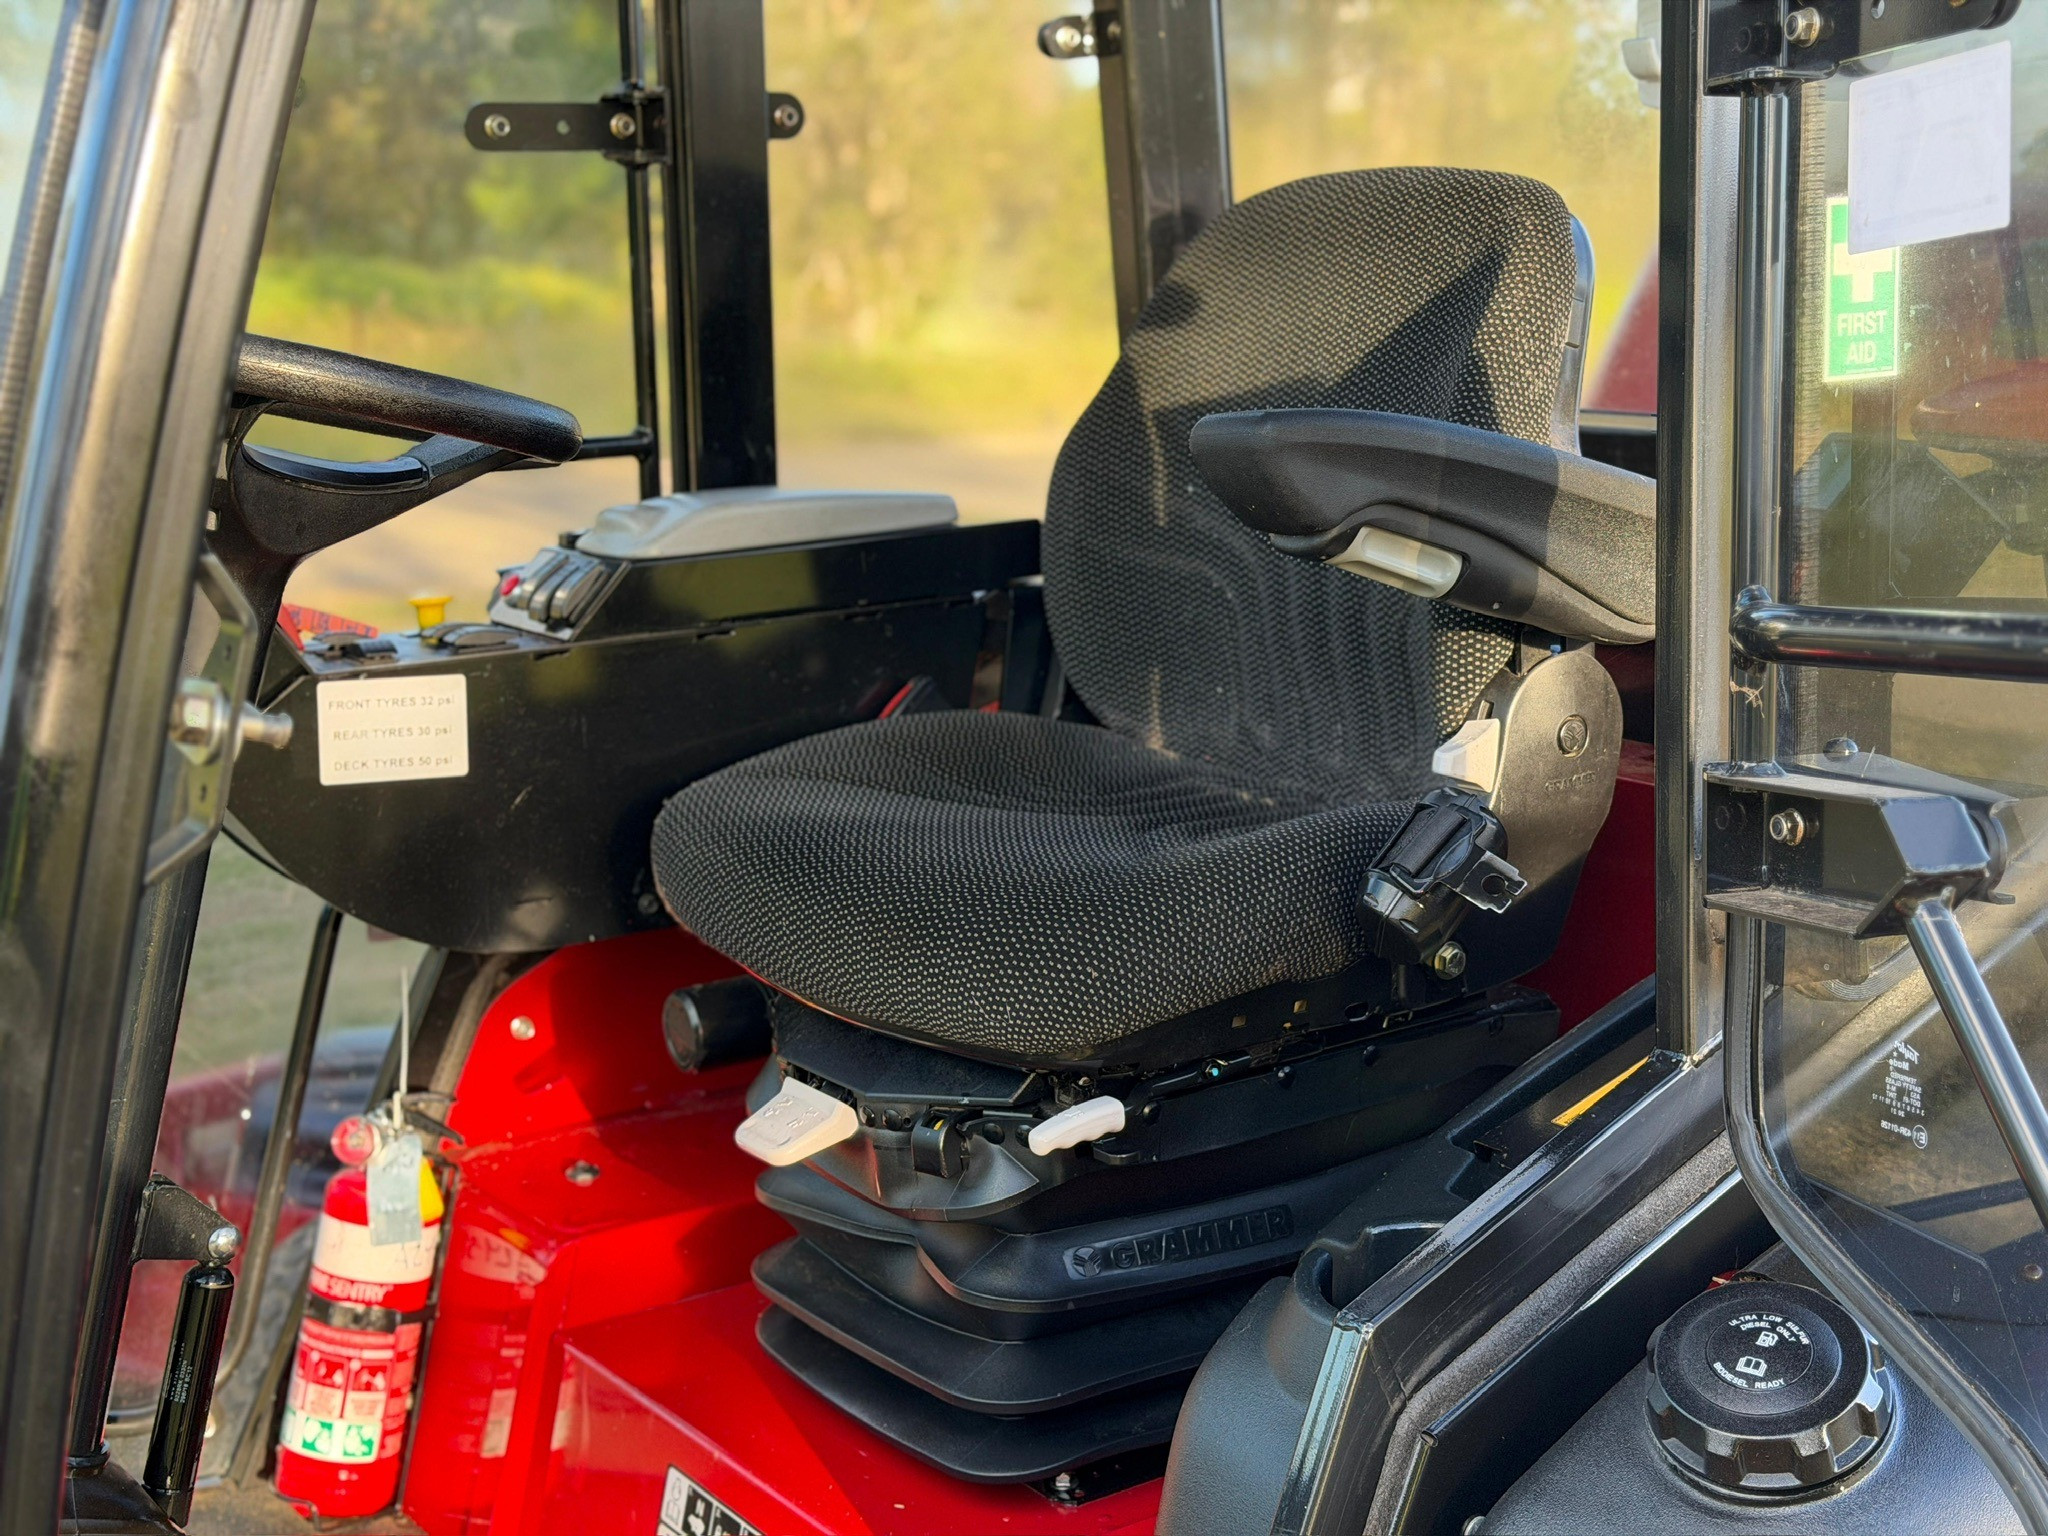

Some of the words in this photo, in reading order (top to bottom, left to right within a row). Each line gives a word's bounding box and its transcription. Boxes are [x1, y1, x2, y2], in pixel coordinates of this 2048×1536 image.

[1837, 309, 1888, 337] FIRST
[1846, 339, 1877, 365] AID
[328, 699, 370, 711] FRONT
[376, 697, 416, 708] TYRES
[420, 696, 433, 706] 32
[438, 695, 455, 706] psi
[333, 729, 369, 741] REAR
[373, 727, 413, 739] TYRES
[418, 726, 431, 736] 30
[435, 725, 452, 737] psi
[334, 759, 369, 772] DECK
[374, 757, 414, 769] TYRES
[419, 756, 431, 766] 50
[435, 755, 453, 767] psi
[1110, 1209, 1289, 1269] GRAMMER
[327, 1276, 388, 1305] SENTRY
[1728, 1314, 1758, 1327] ULTRA
[1763, 1314, 1783, 1322] LOW
[1785, 1321, 1810, 1345] SULFUR
[1740, 1322, 1771, 1331] DIESEL
[1776, 1326, 1797, 1343] ONLY
[1713, 1361, 1748, 1388] BIODIESEL
[1754, 1378, 1786, 1389] READY
